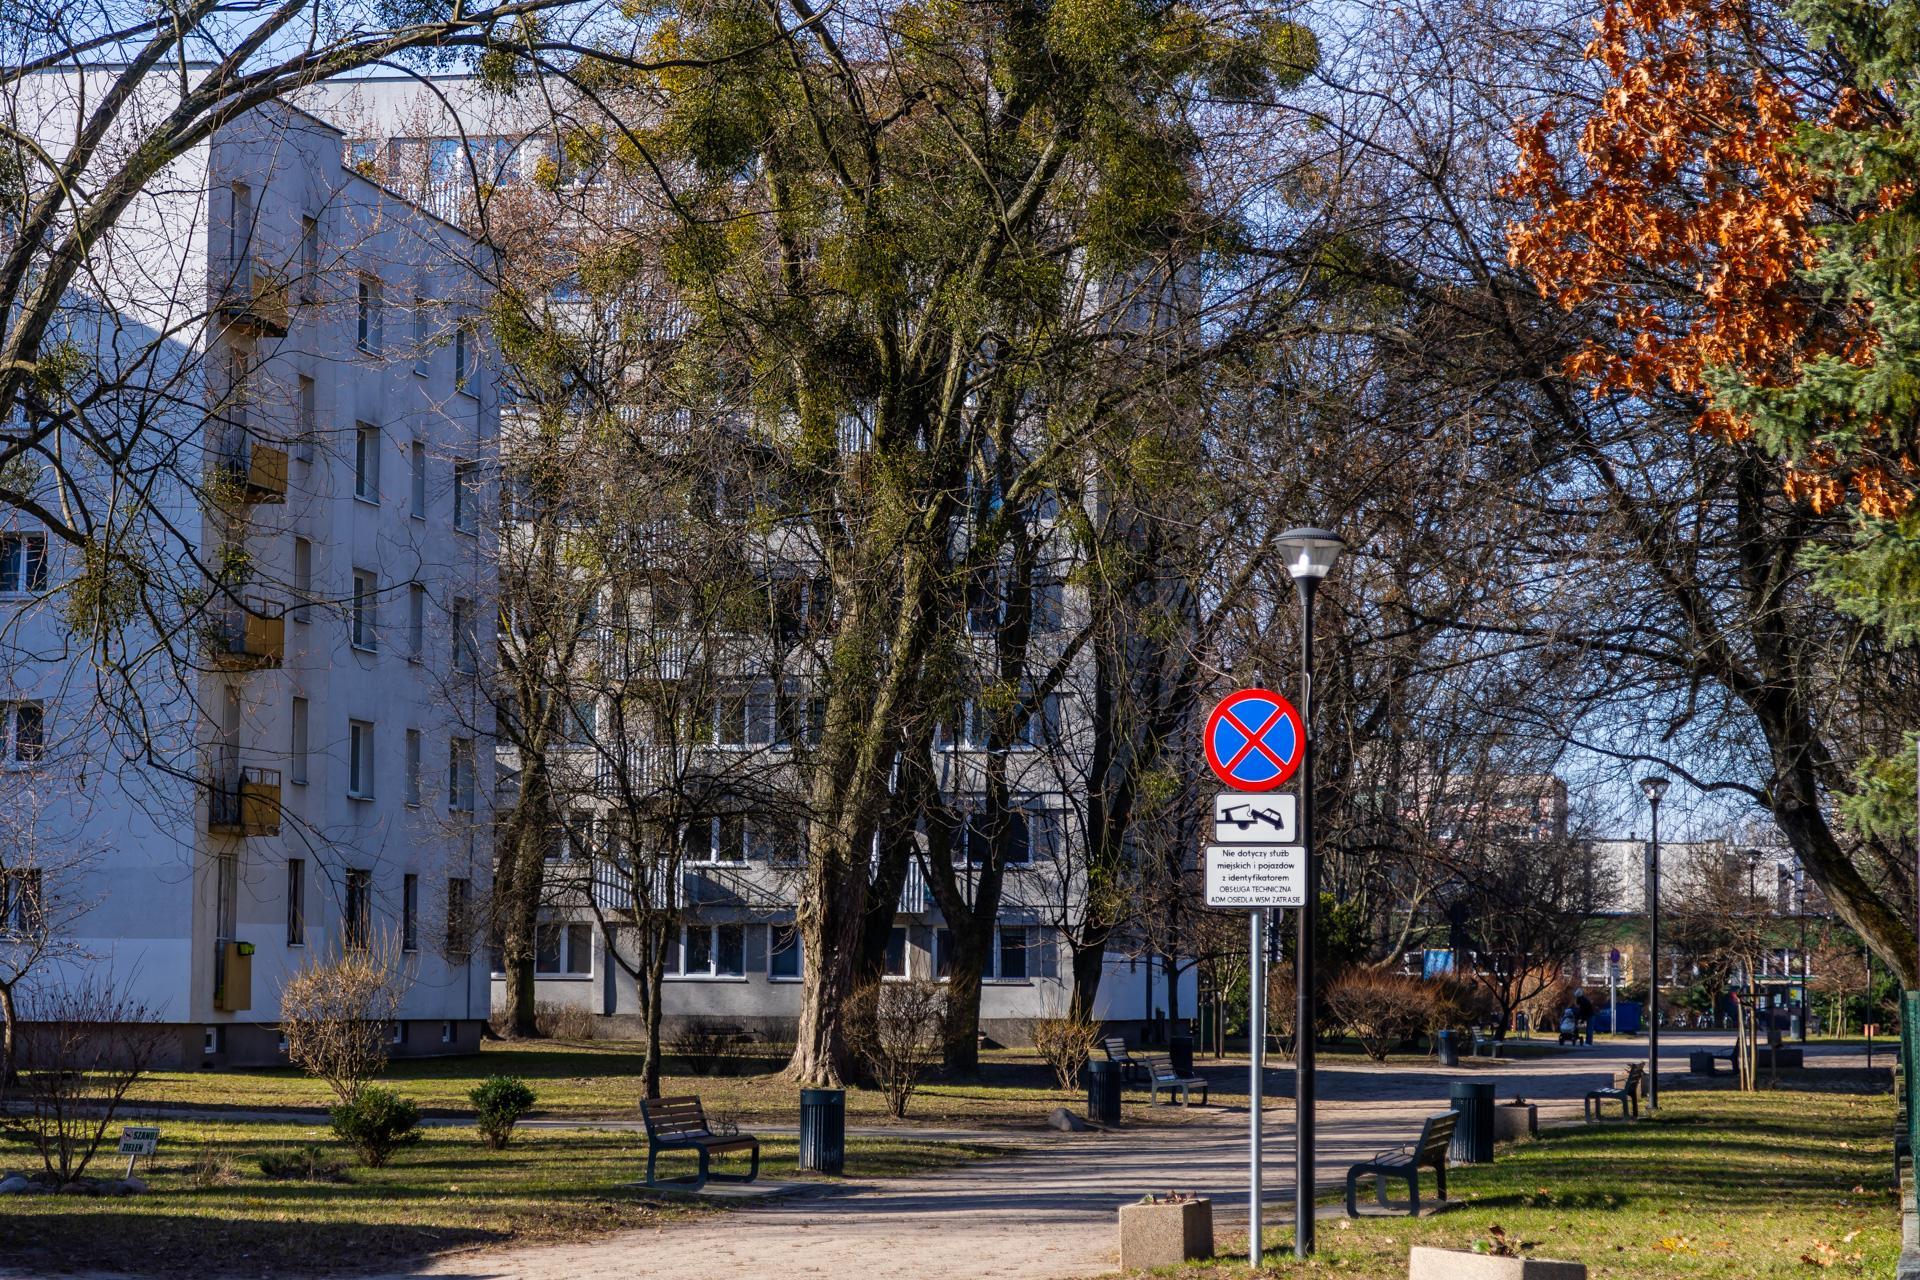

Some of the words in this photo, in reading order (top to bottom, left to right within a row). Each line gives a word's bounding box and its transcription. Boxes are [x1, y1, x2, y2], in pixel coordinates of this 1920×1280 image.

[1238, 850, 1267, 859] dotyczy
[1217, 862, 1251, 870] miejskich
[1258, 862, 1295, 871] pojazdów
[1228, 874, 1290, 883] identyfikatorem
